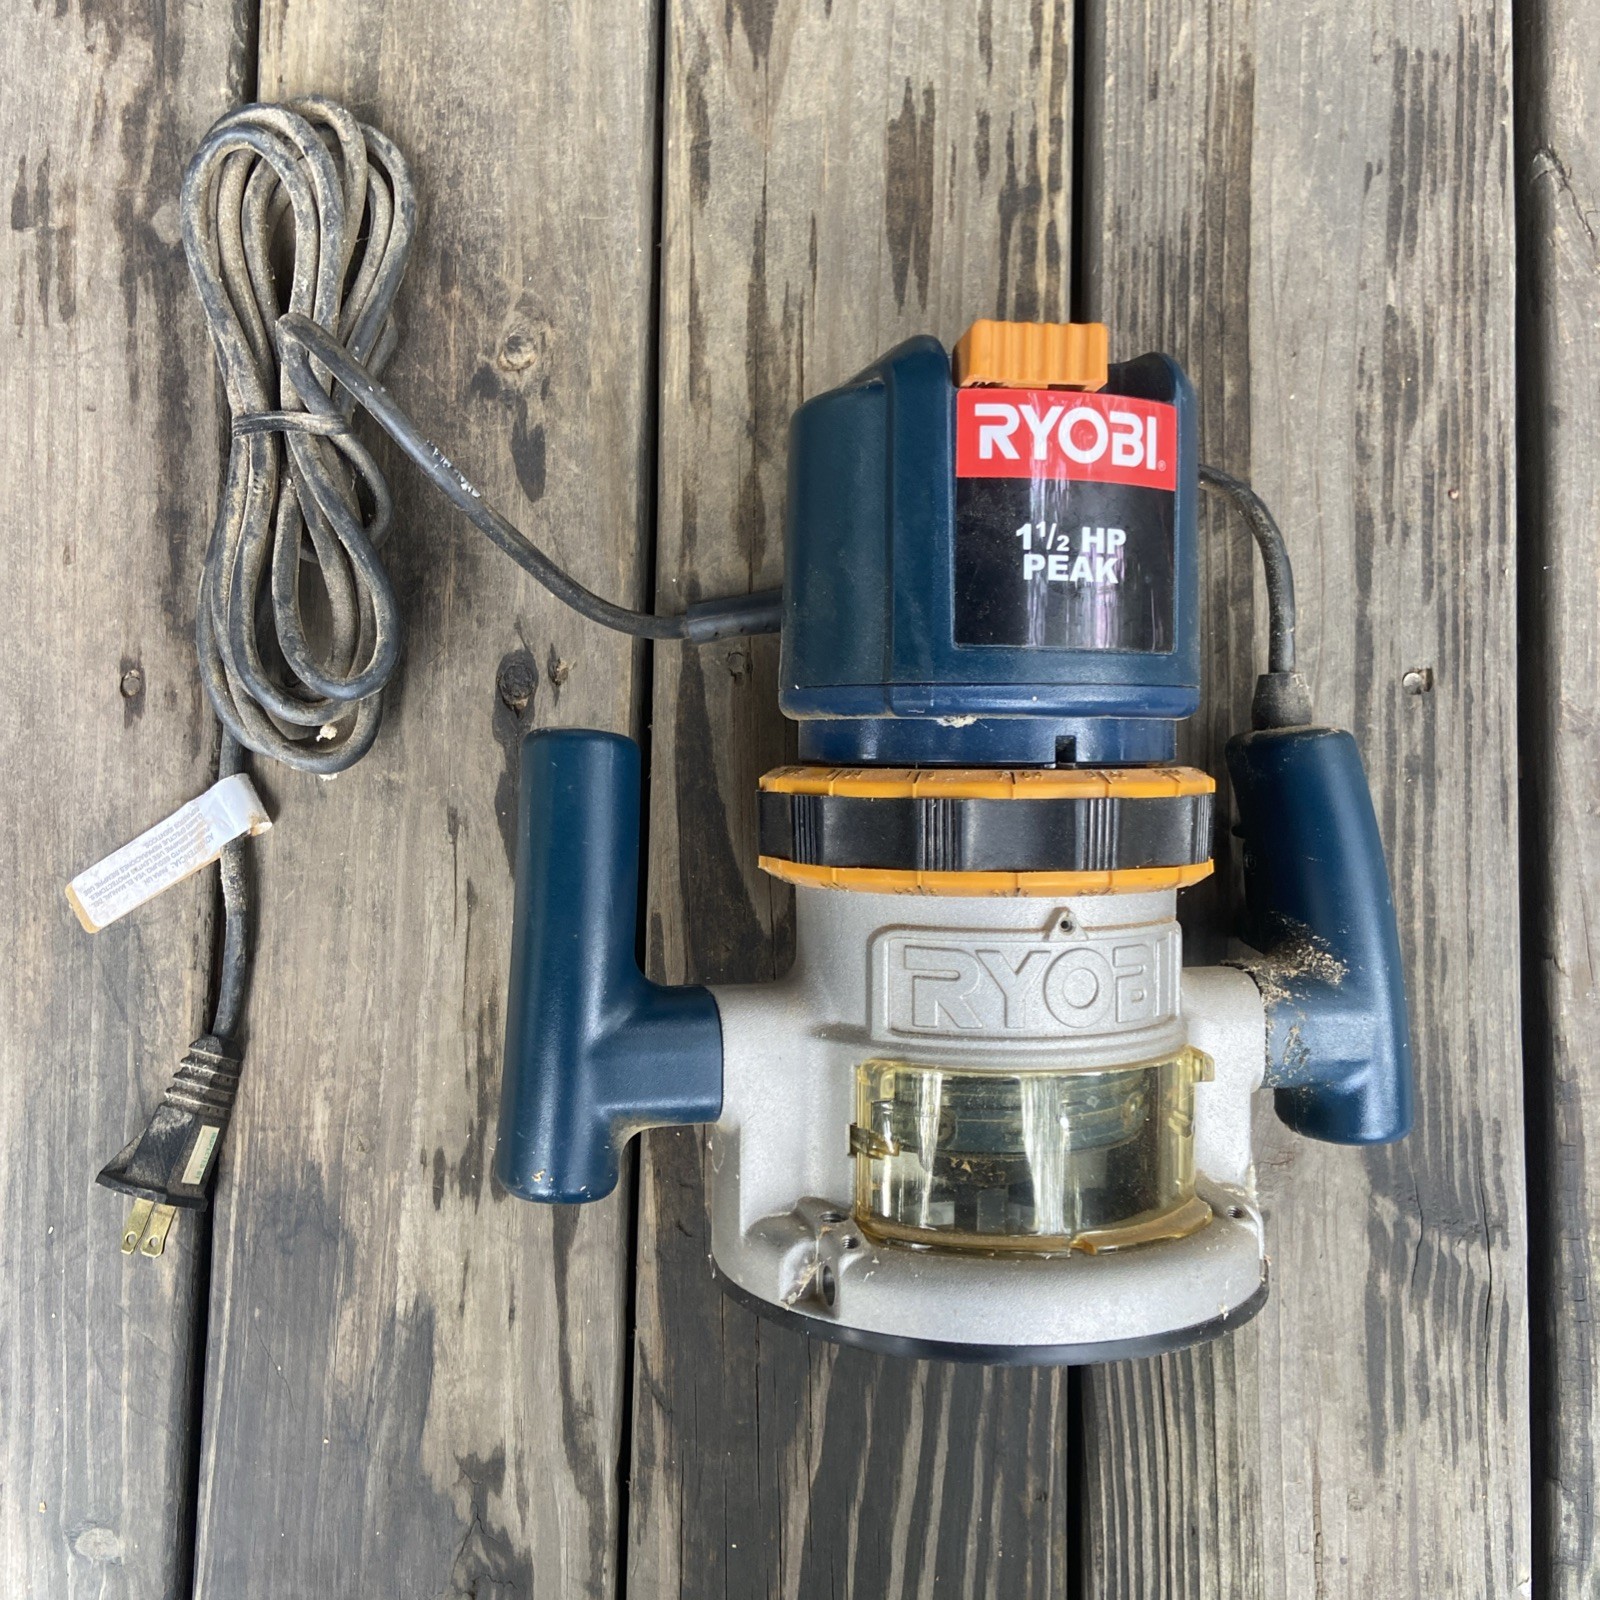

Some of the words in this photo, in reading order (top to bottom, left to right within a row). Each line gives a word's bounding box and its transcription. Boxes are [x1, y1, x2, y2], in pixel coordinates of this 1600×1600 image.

[1082, 526, 1126, 554] HP
[1023, 553, 1119, 584] PEAK
[903, 936, 1170, 1029] RYOBI
